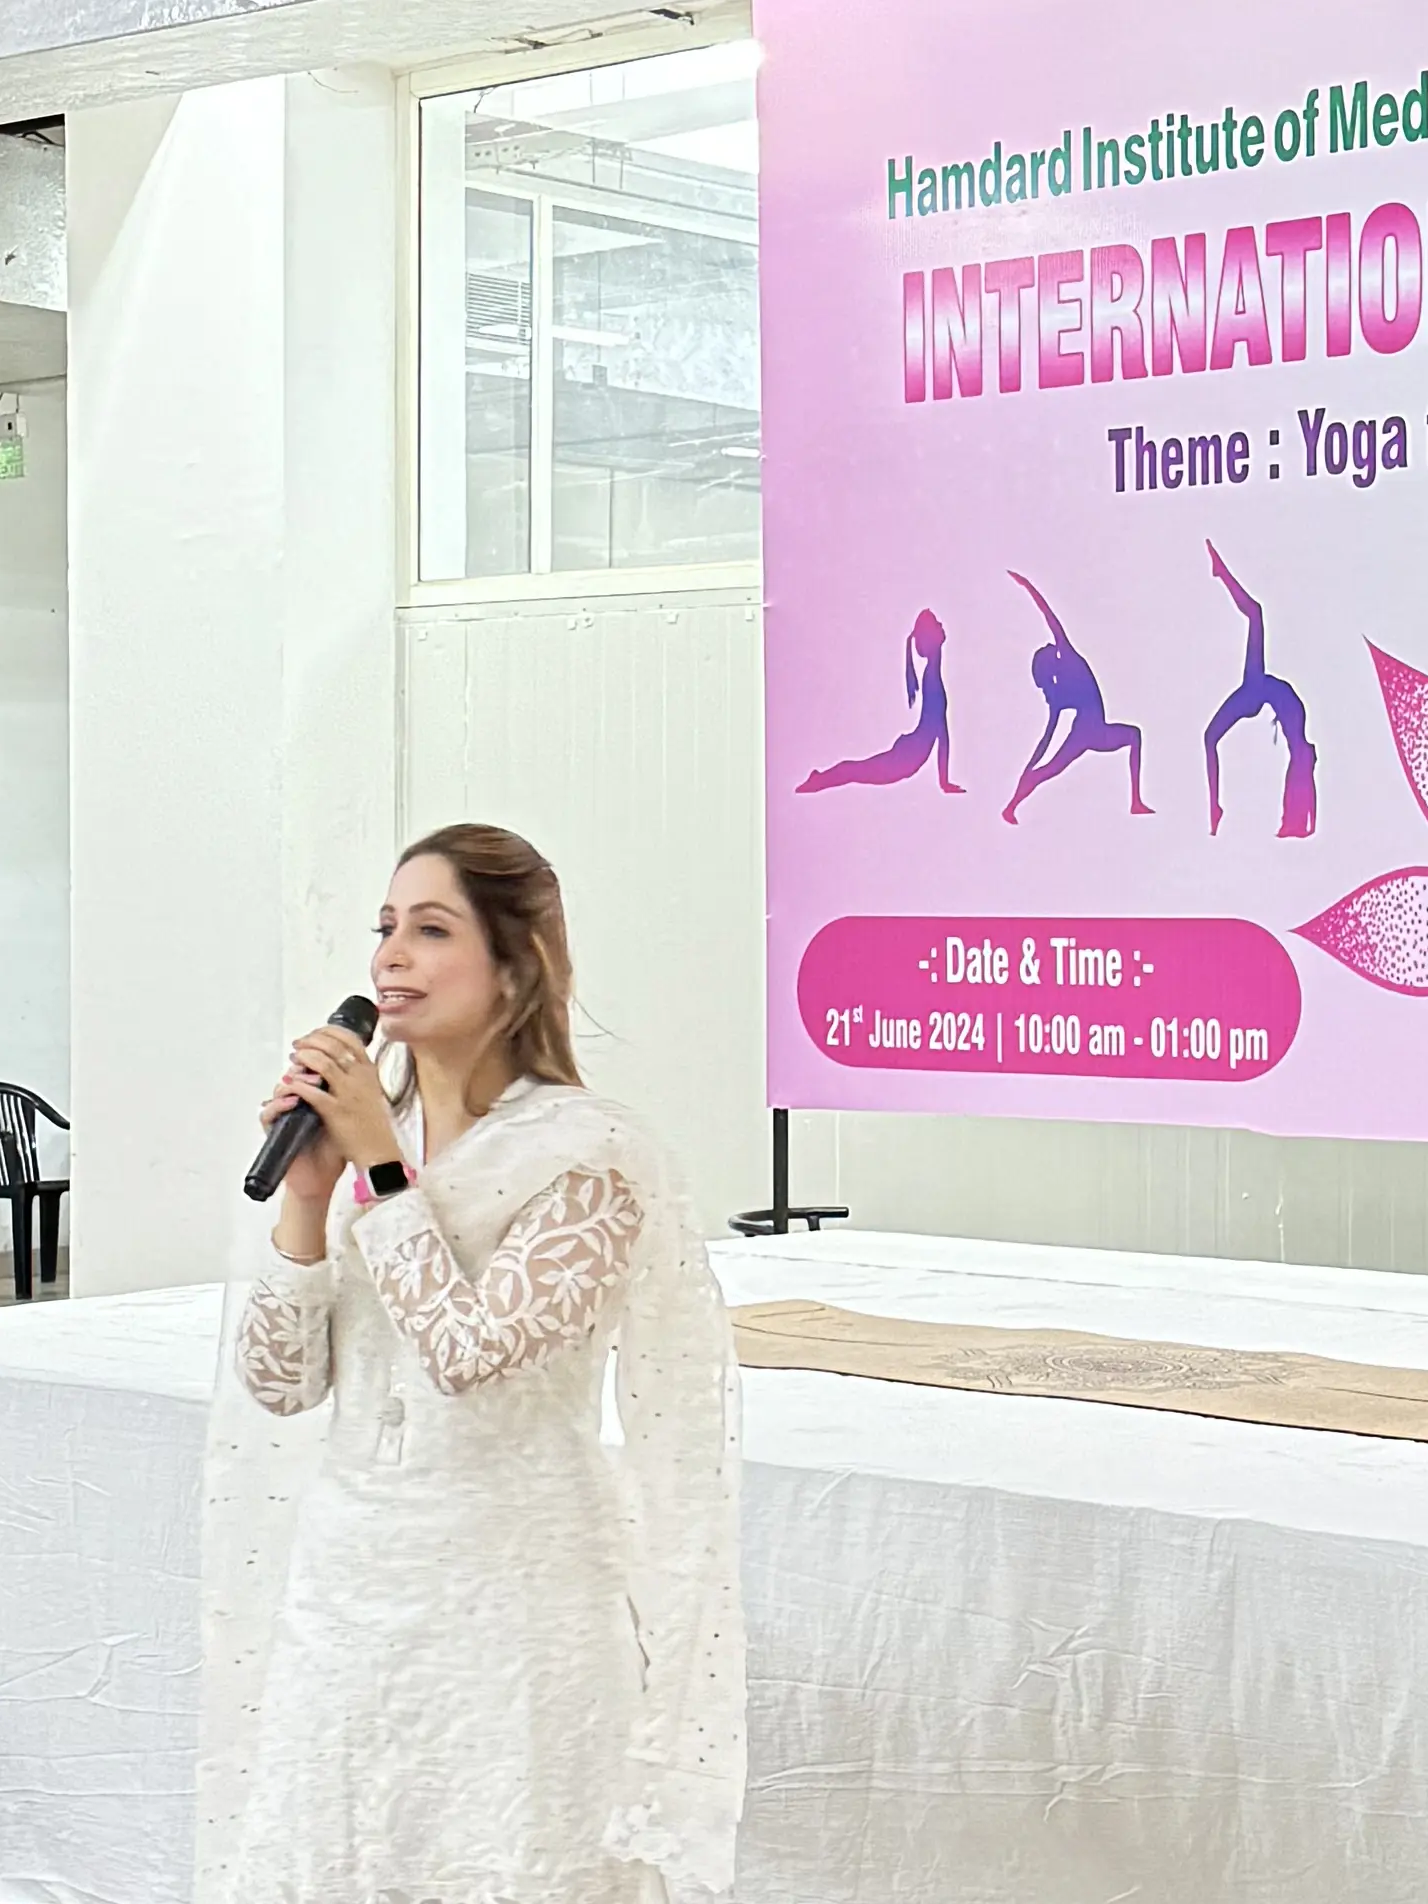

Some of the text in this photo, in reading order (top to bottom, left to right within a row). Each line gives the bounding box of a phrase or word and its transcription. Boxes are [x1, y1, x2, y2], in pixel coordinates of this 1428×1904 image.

[887, 129, 1072, 220] Hamdard
[1082, 104, 1265, 193] Institute
[1273, 91, 1320, 162] of
[1108, 423, 1250, 494] Theme
[1297, 406, 1408, 489] Yoga
[946, 937, 1009, 985] Date
[1020, 937, 1041, 986] &
[1051, 937, 1123, 987] Time
[825, 1005, 865, 1049] 21st
[868, 1012, 921, 1051] June
[928, 1012, 986, 1052] 2024
[1014, 1014, 1081, 1056] 10:00
[1088, 1023, 1126, 1057] am
[1149, 1017, 1222, 1060] 01:00
[1228, 1027, 1269, 1069] pm
